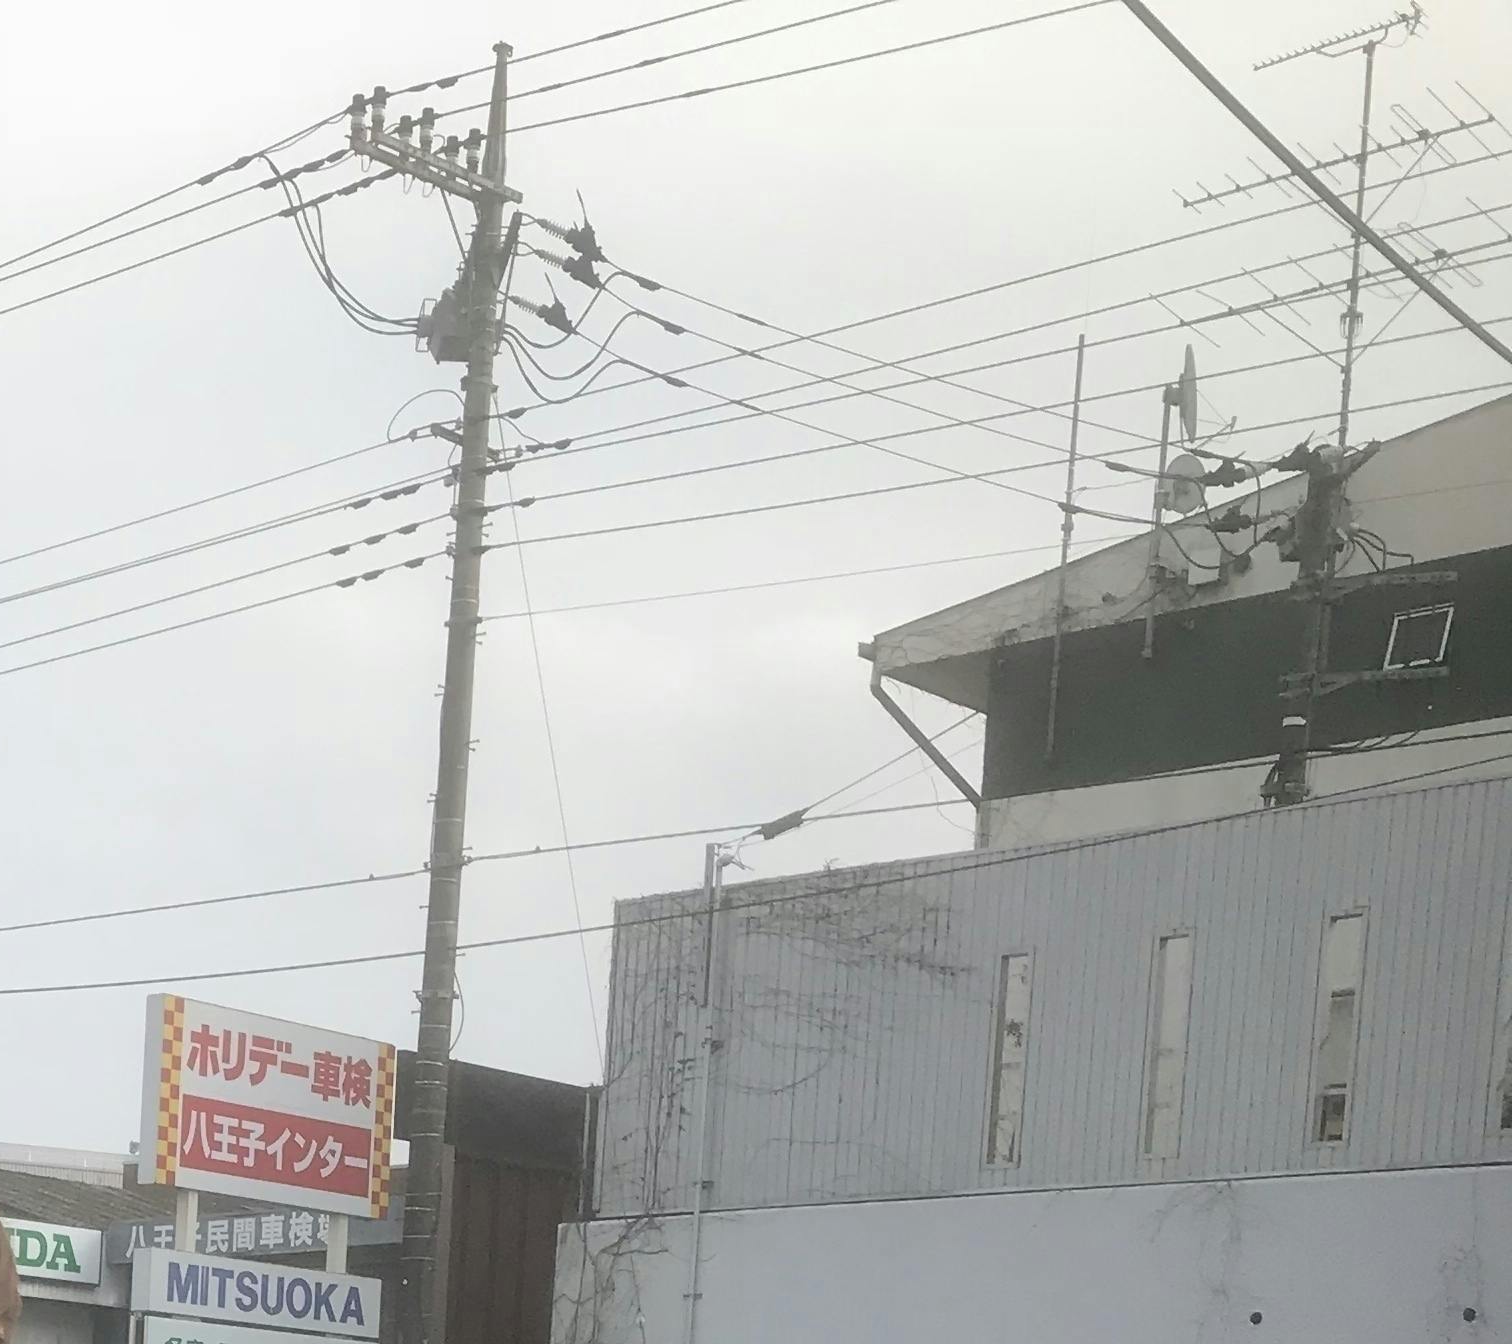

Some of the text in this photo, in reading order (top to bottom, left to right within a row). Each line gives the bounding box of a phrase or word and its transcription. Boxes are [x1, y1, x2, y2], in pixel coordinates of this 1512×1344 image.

[186, 1023, 373, 1109] ホリデー車検
[182, 1109, 368, 1179] 八王子インター
[166, 1261, 366, 1327] MITSUOKA
